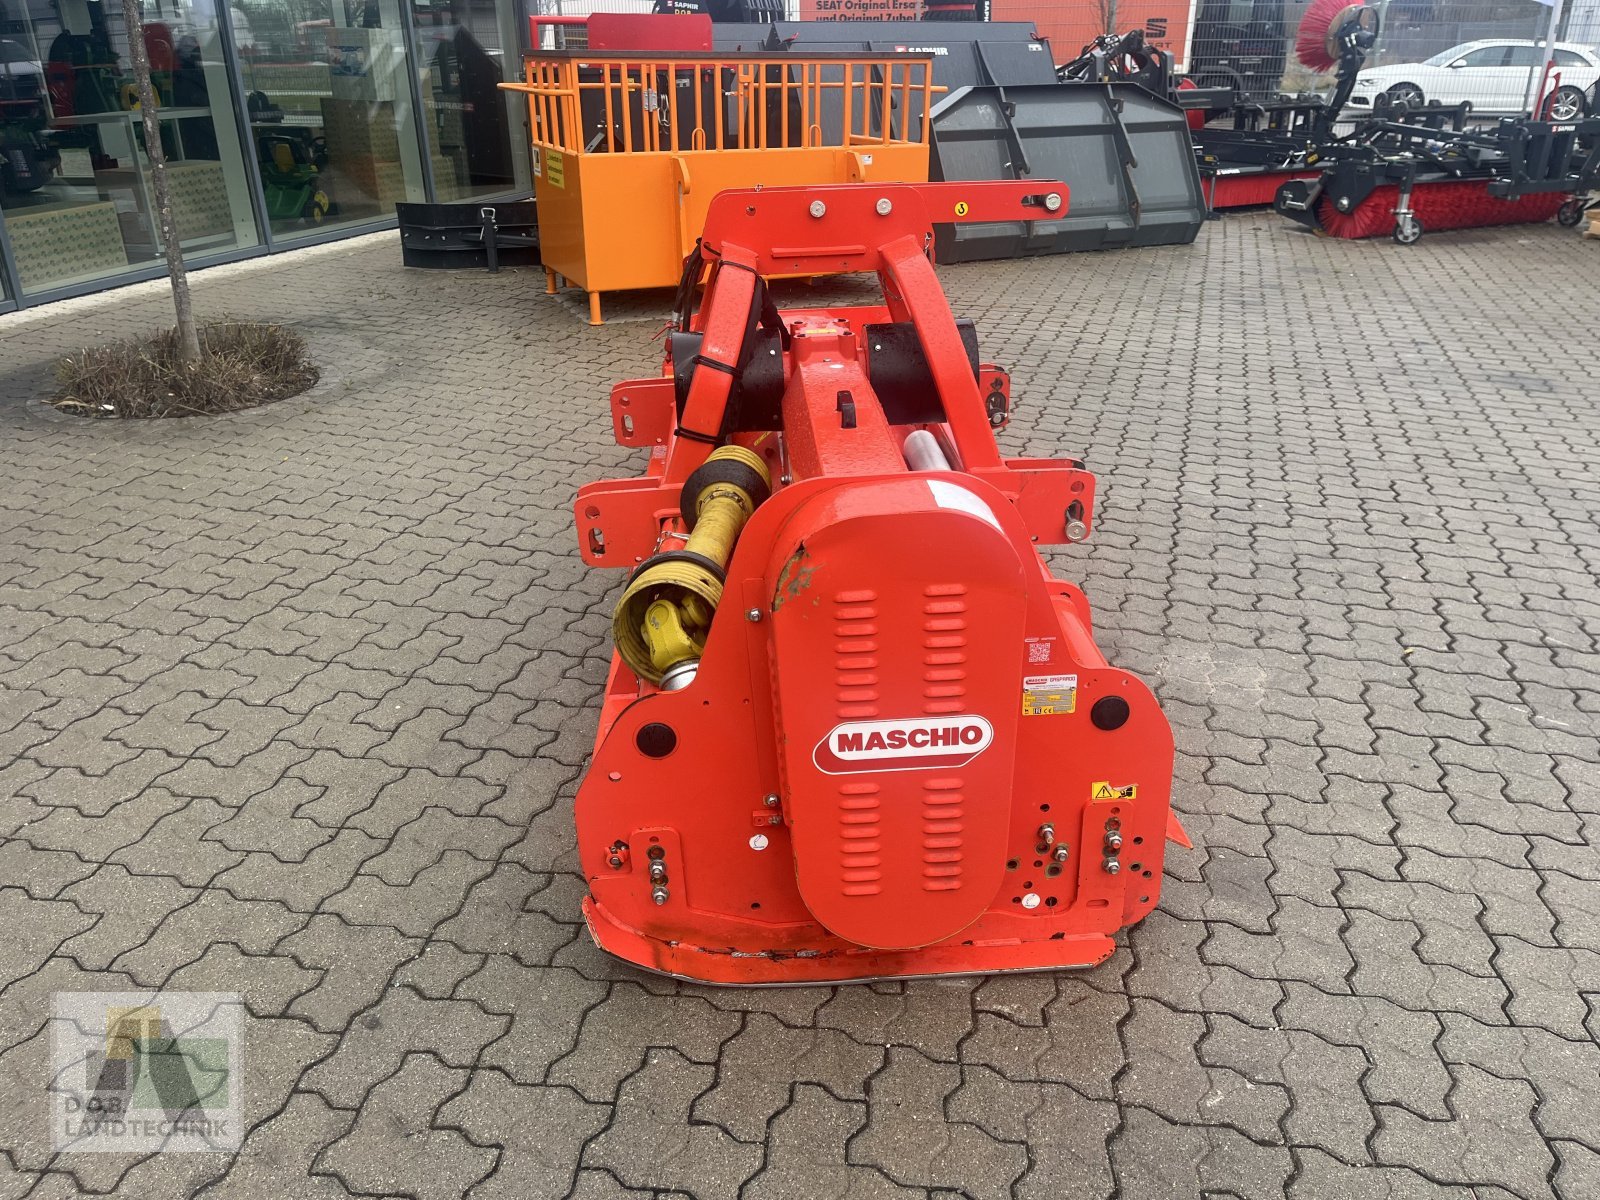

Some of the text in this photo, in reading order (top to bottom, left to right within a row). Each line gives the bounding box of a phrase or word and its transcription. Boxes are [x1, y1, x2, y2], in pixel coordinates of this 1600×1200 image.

[674, 2, 699, 10] SAPHIR
[816, 0, 842, 10] SEAT
[845, 0, 891, 12] Original
[816, 13, 837, 22] und
[837, 725, 984, 753] MASCHIO
